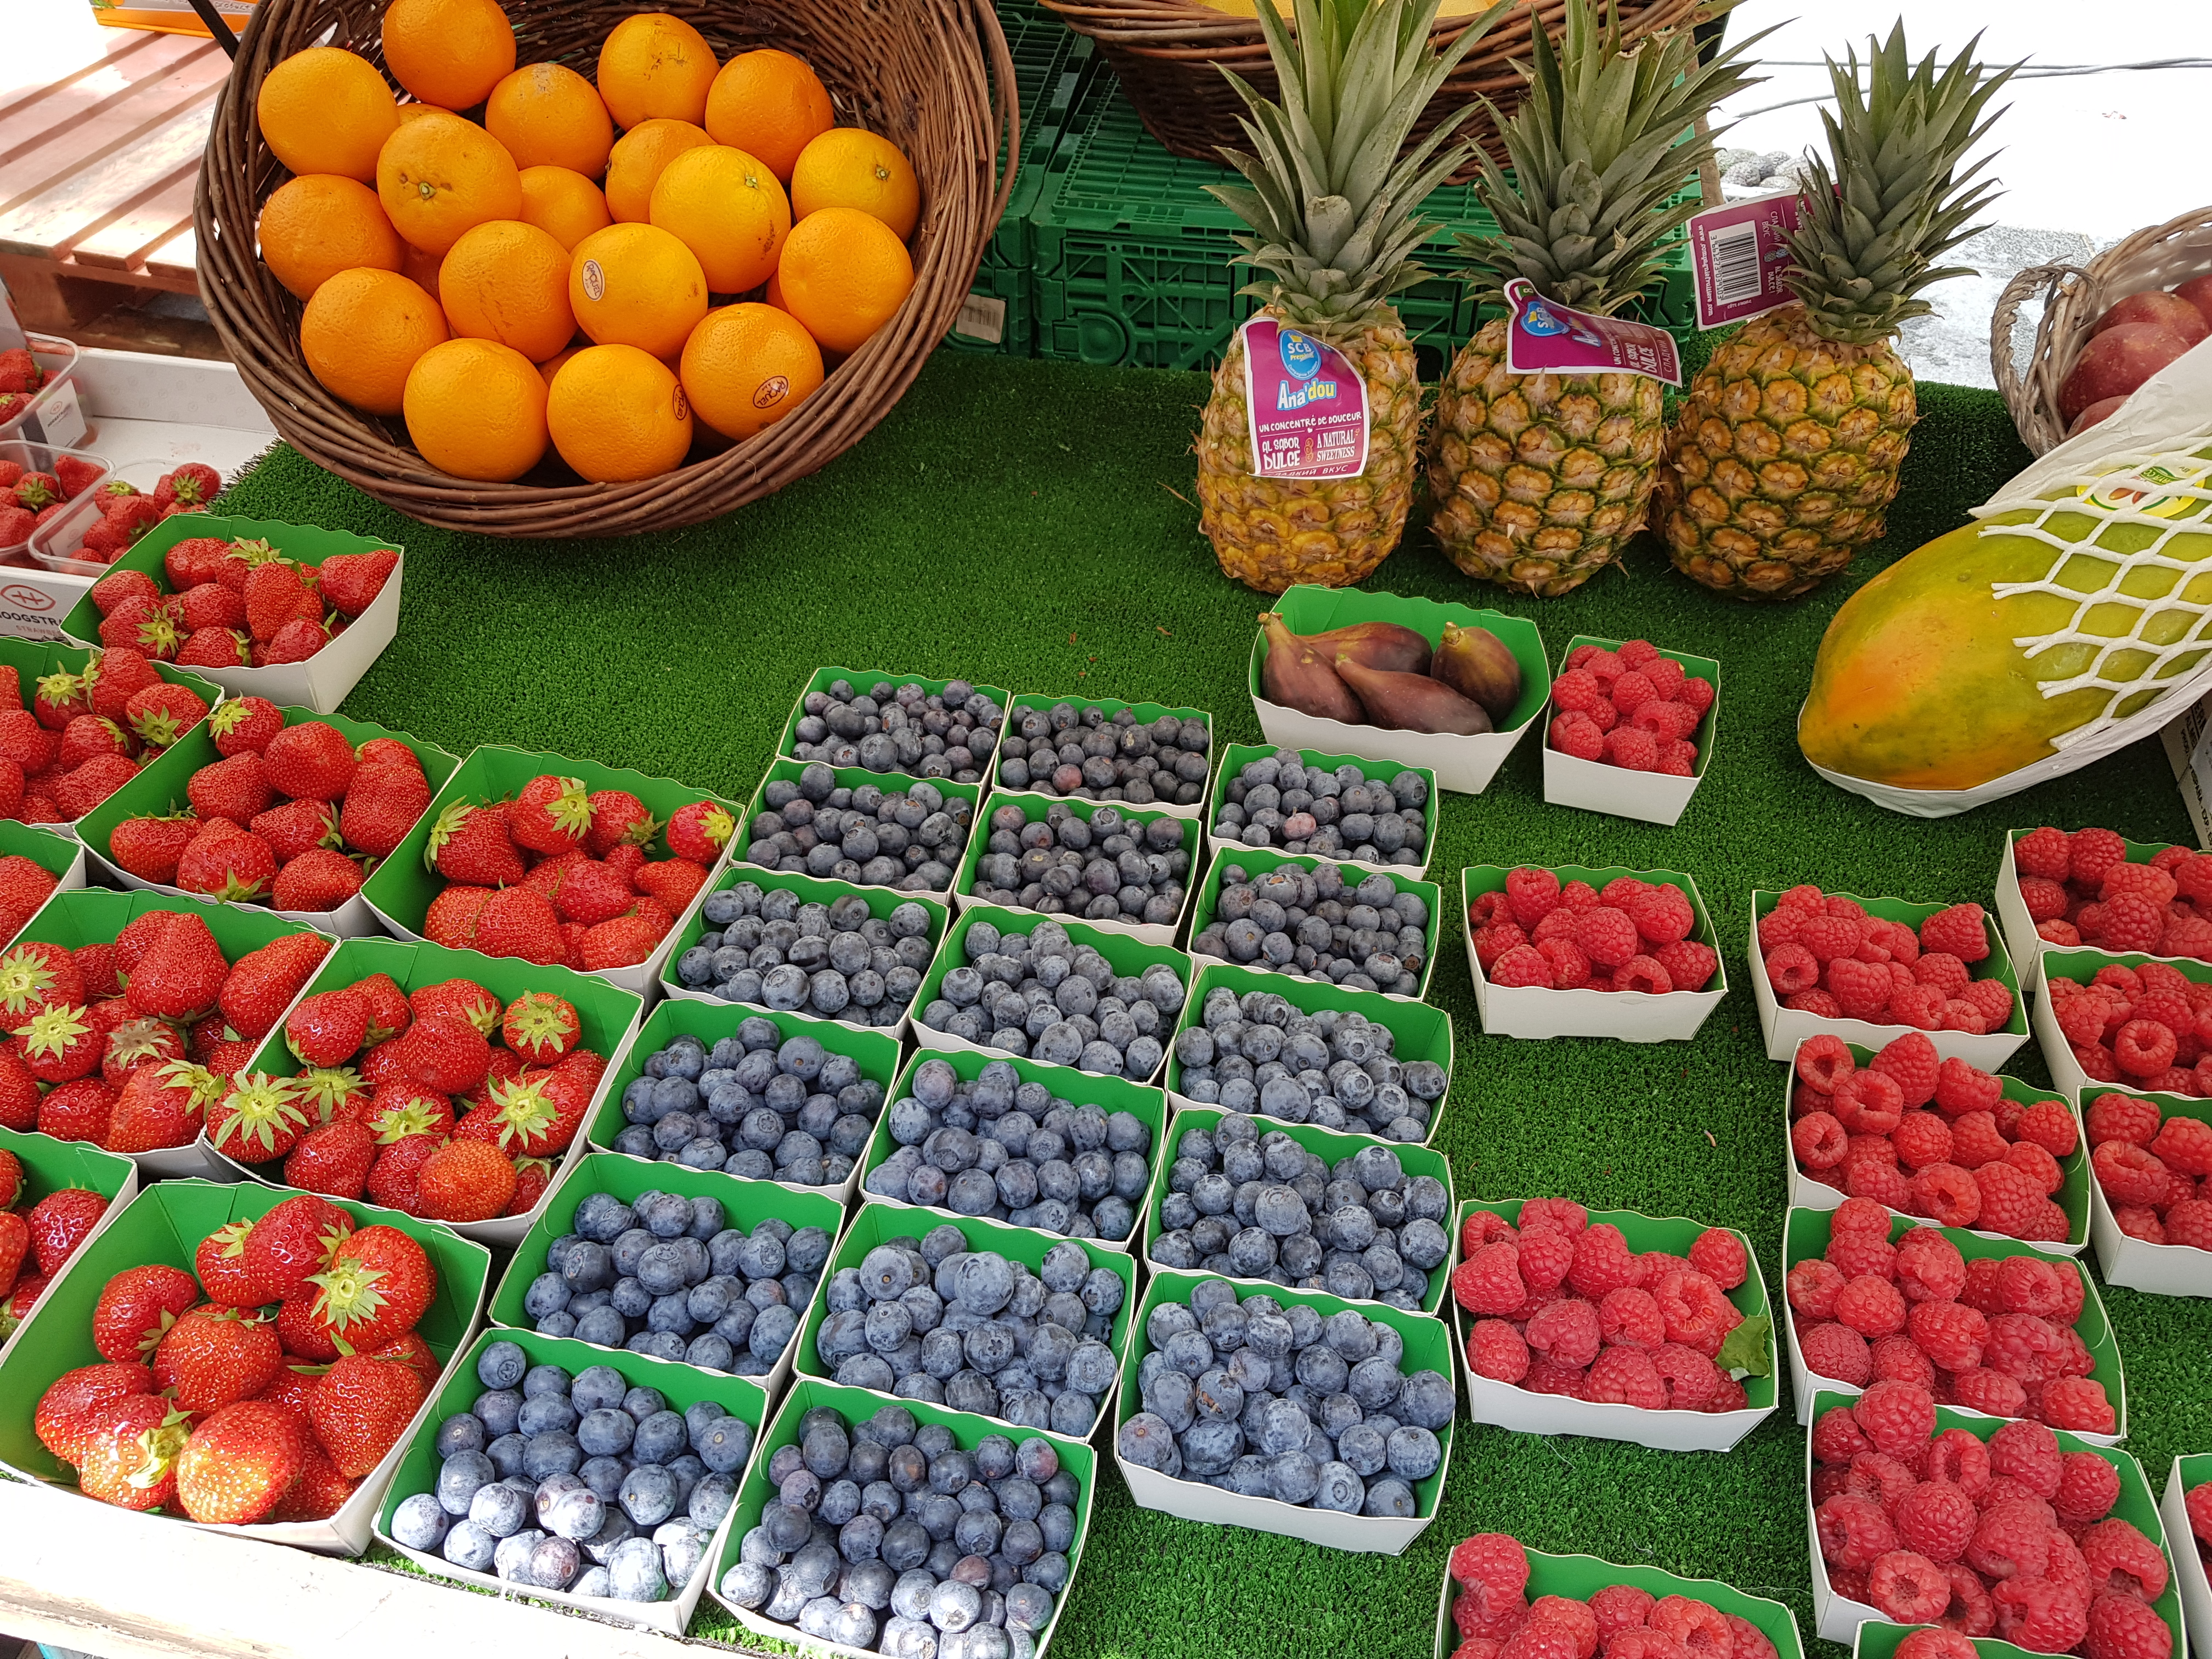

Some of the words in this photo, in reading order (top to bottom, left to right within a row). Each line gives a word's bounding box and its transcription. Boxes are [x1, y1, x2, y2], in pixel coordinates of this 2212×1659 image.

[1712, 244, 1722, 270] 661273
[586, 264, 600, 296] RAQUEL
[1716, 273, 1724, 300] 039103
[1288, 341, 1312, 354] SCB
[1290, 352, 1314, 361] Prem
[1637, 345, 1657, 374] DULCE
[757, 380, 786, 407] RAQUEL
[1277, 380, 1336, 410] Ana'dou
[1259, 424, 1269, 433] UN
[1271, 415, 1317, 431] CONCENTRÉ
[1318, 417, 1327, 425] DE
[1328, 411, 1362, 424] DOUCEUR
[1262, 439, 1273, 453] AL
[1274, 437, 1300, 450] SABOR
[1317, 433, 1323, 449] A
[1323, 429, 1355, 447] NATURAL
[1263, 450, 1301, 470] DULCE
[1316, 447, 1355, 462] SWEETNESS
[1322, 465, 1348, 473] ВКУС
[0, 611, 63, 627] OOGSTR
